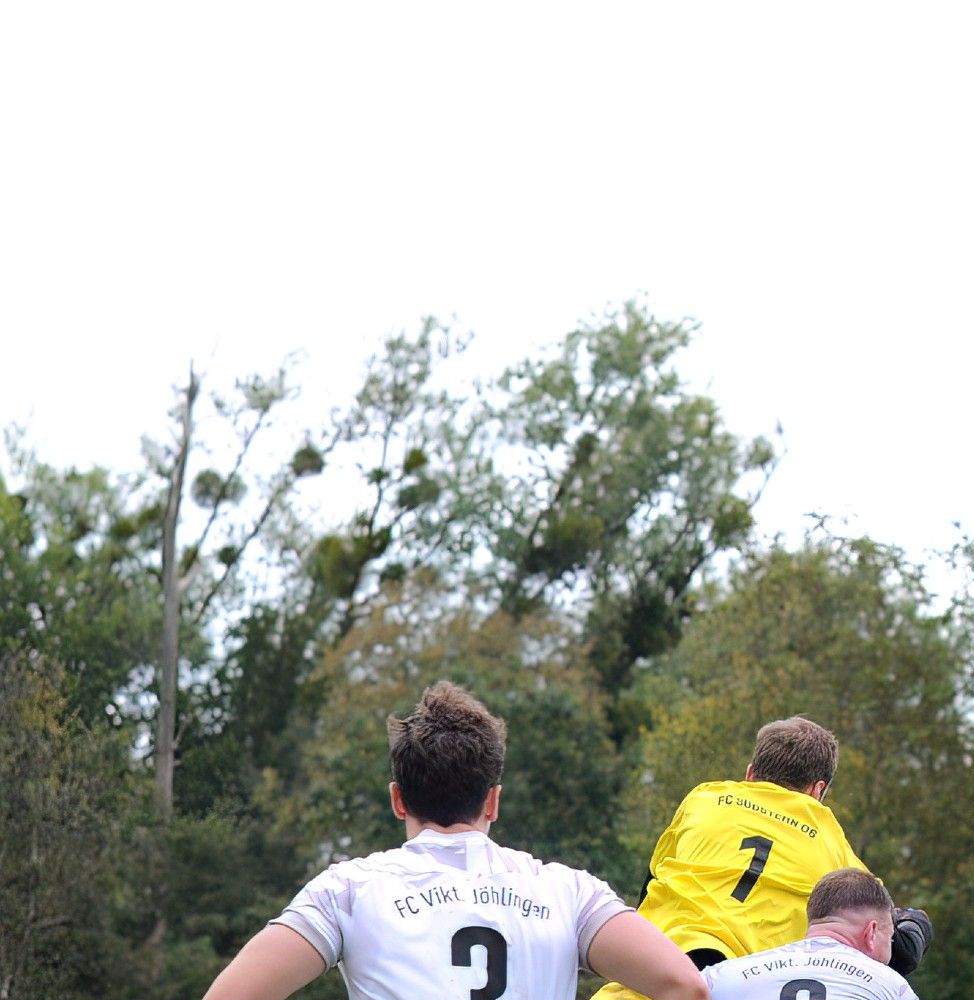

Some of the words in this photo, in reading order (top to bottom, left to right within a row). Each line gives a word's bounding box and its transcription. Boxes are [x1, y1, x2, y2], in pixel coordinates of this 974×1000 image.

[718, 794, 734, 806] FC
[801, 823, 818, 839] 06
[730, 835, 773, 904] 1
[394, 895, 420, 918] FC
[473, 885, 550, 920] Jöhlingen
[742, 965, 761, 980] FC
[804, 956, 874, 983] Jöhlingen
